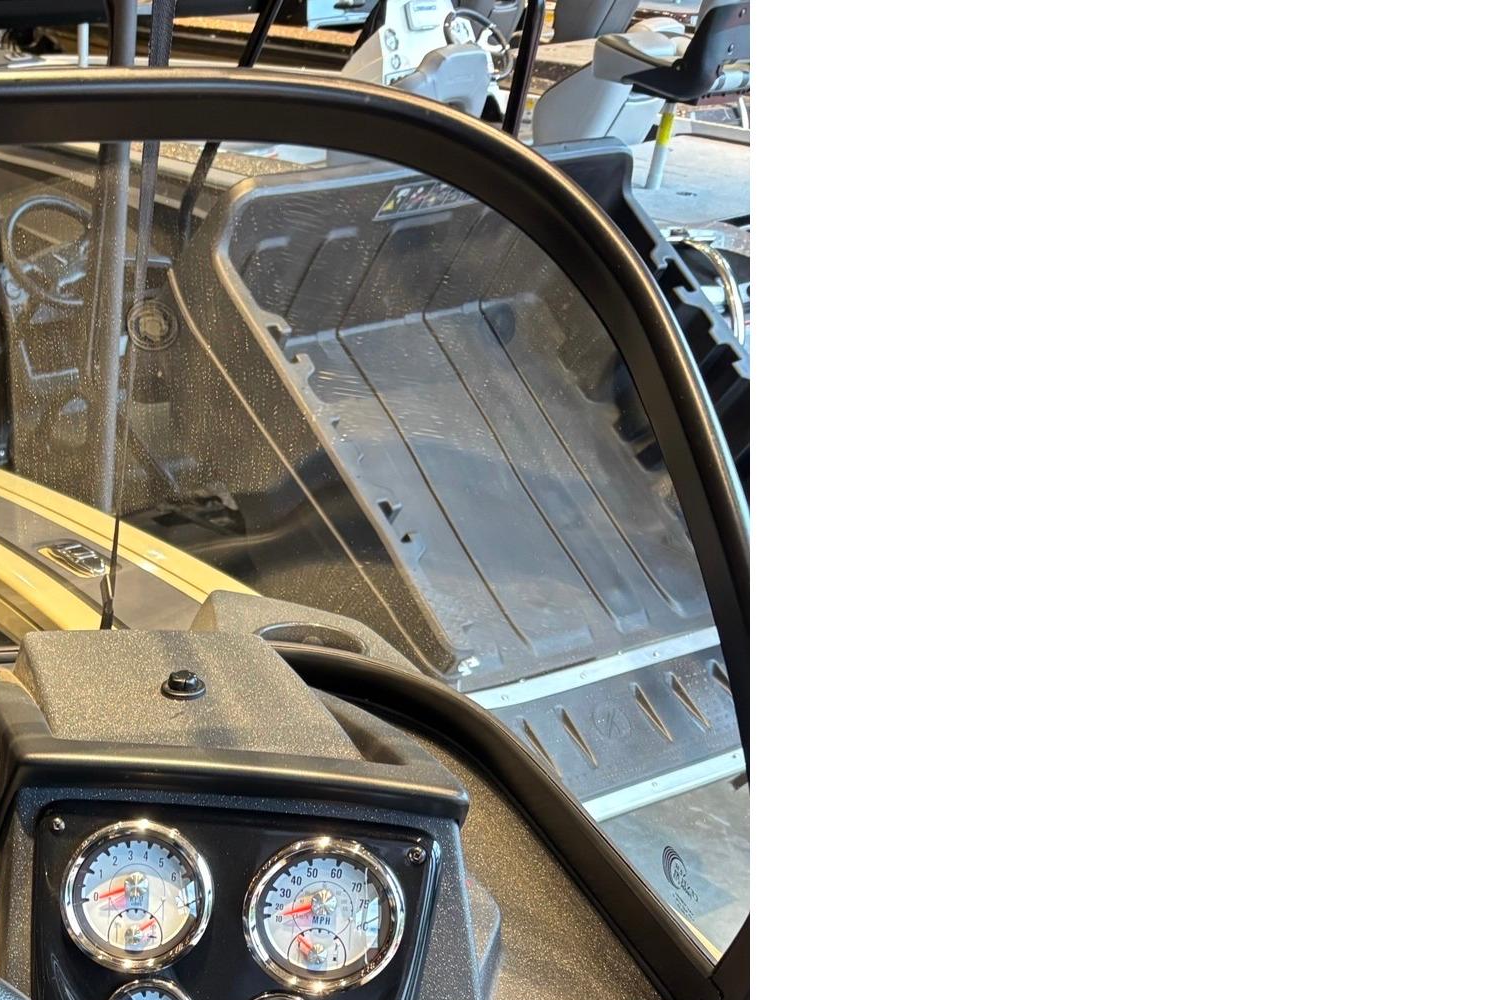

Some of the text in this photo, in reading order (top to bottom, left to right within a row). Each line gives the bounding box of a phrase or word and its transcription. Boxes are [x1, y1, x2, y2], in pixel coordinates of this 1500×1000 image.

[112, 855, 118, 866] 2
[128, 850, 133, 861] 3
[143, 851, 148, 861] 4
[158, 857, 164, 868] 5
[99, 869, 103, 879] 1
[171, 871, 177, 882] 6
[306, 867, 318, 879] 50
[330, 868, 343, 879] 60
[290, 876, 302, 886] 40
[351, 881, 362, 893] 70
[93, 891, 99, 901] 0
[279, 888, 292, 899] 30
[275, 903, 284, 911] 20
[359, 899, 370, 909] 75
[275, 915, 283, 923] 10
[311, 916, 331, 926] MPH
